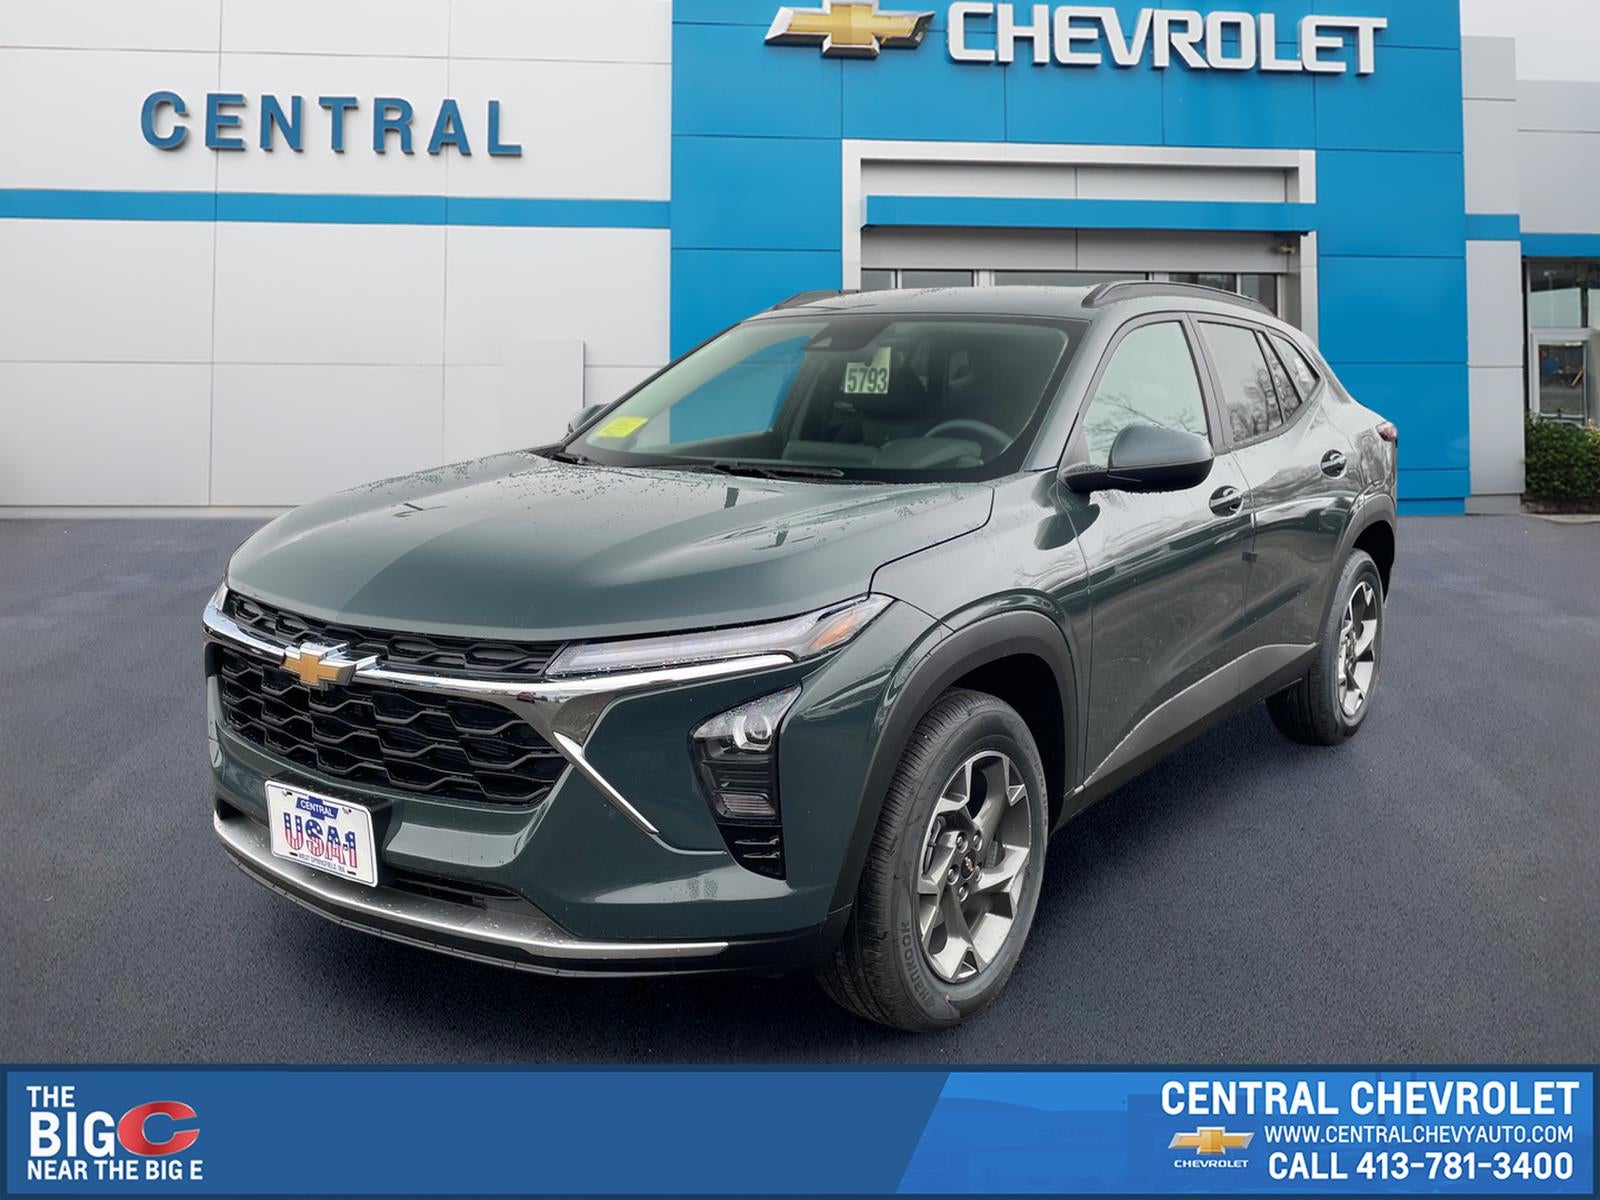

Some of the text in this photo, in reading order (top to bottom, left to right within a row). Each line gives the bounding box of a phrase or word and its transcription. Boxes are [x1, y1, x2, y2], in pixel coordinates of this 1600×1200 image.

[946, 1, 1388, 75] CHEVROLET
[140, 90, 522, 157] CENTRAL
[847, 367, 888, 392] 5793
[300, 799, 336, 818] CENTRAL
